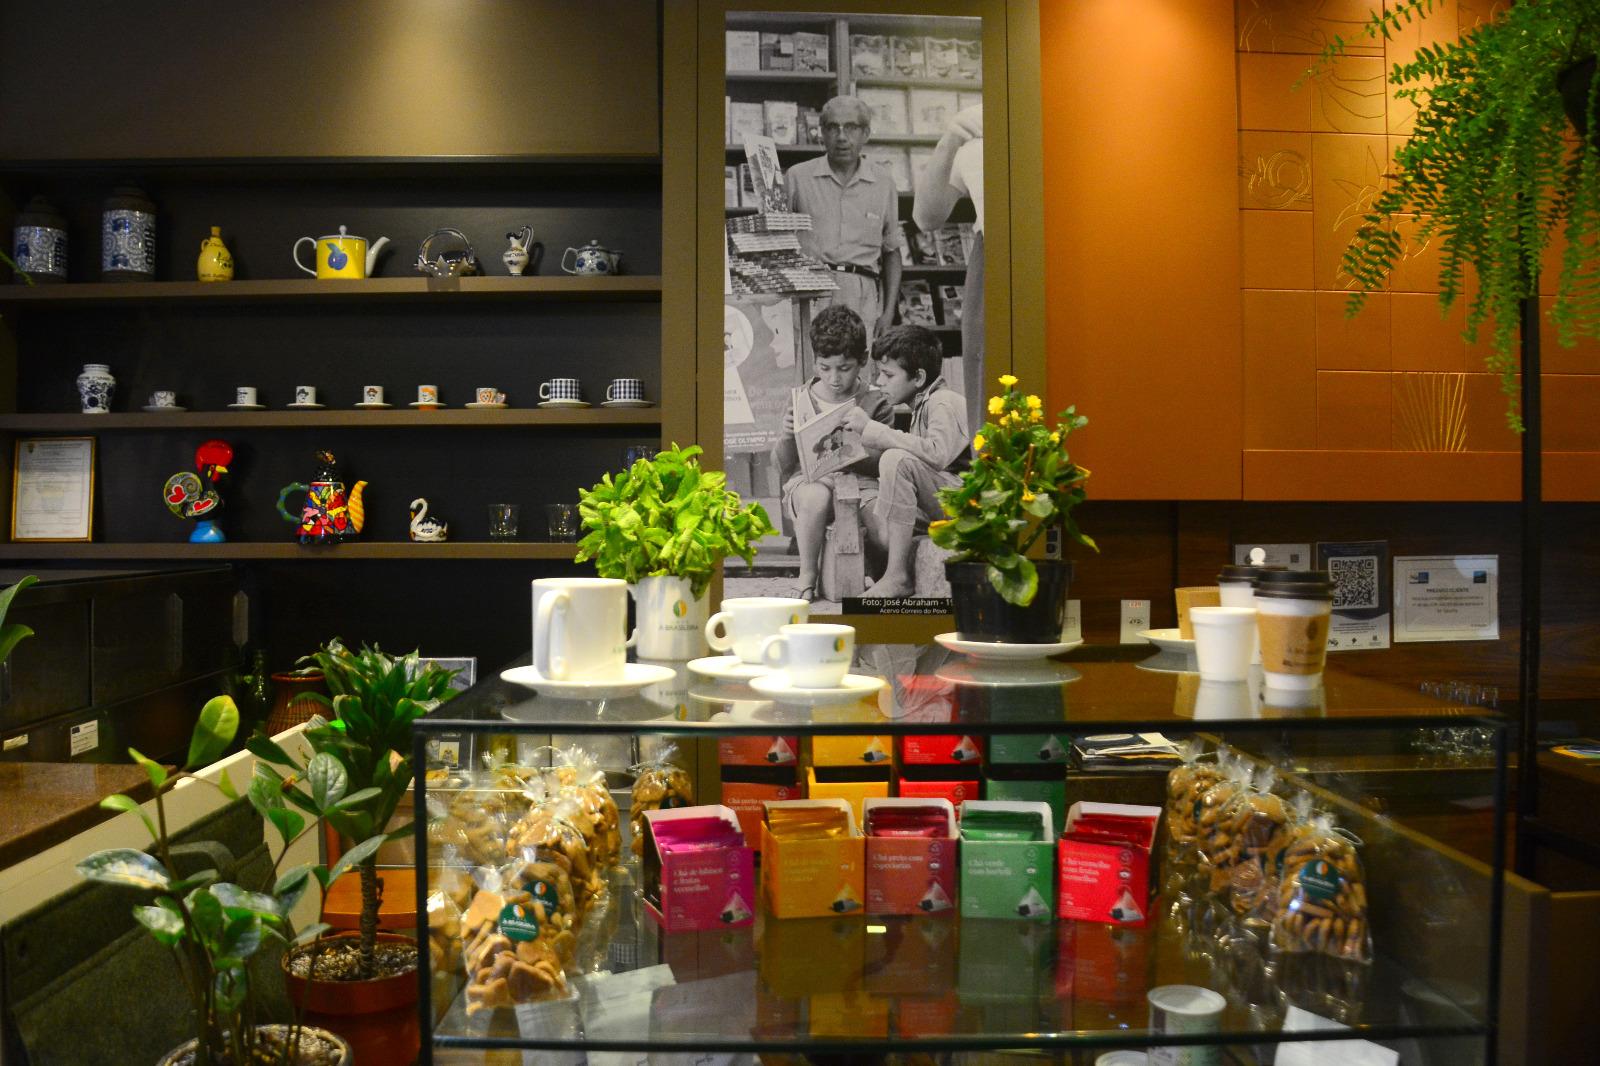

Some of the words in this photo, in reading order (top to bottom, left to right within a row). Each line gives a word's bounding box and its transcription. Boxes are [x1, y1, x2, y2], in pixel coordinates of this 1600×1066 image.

[862, 598, 882, 606] Foto:
[883, 598, 900, 607] José
[902, 598, 939, 606] Abraham
